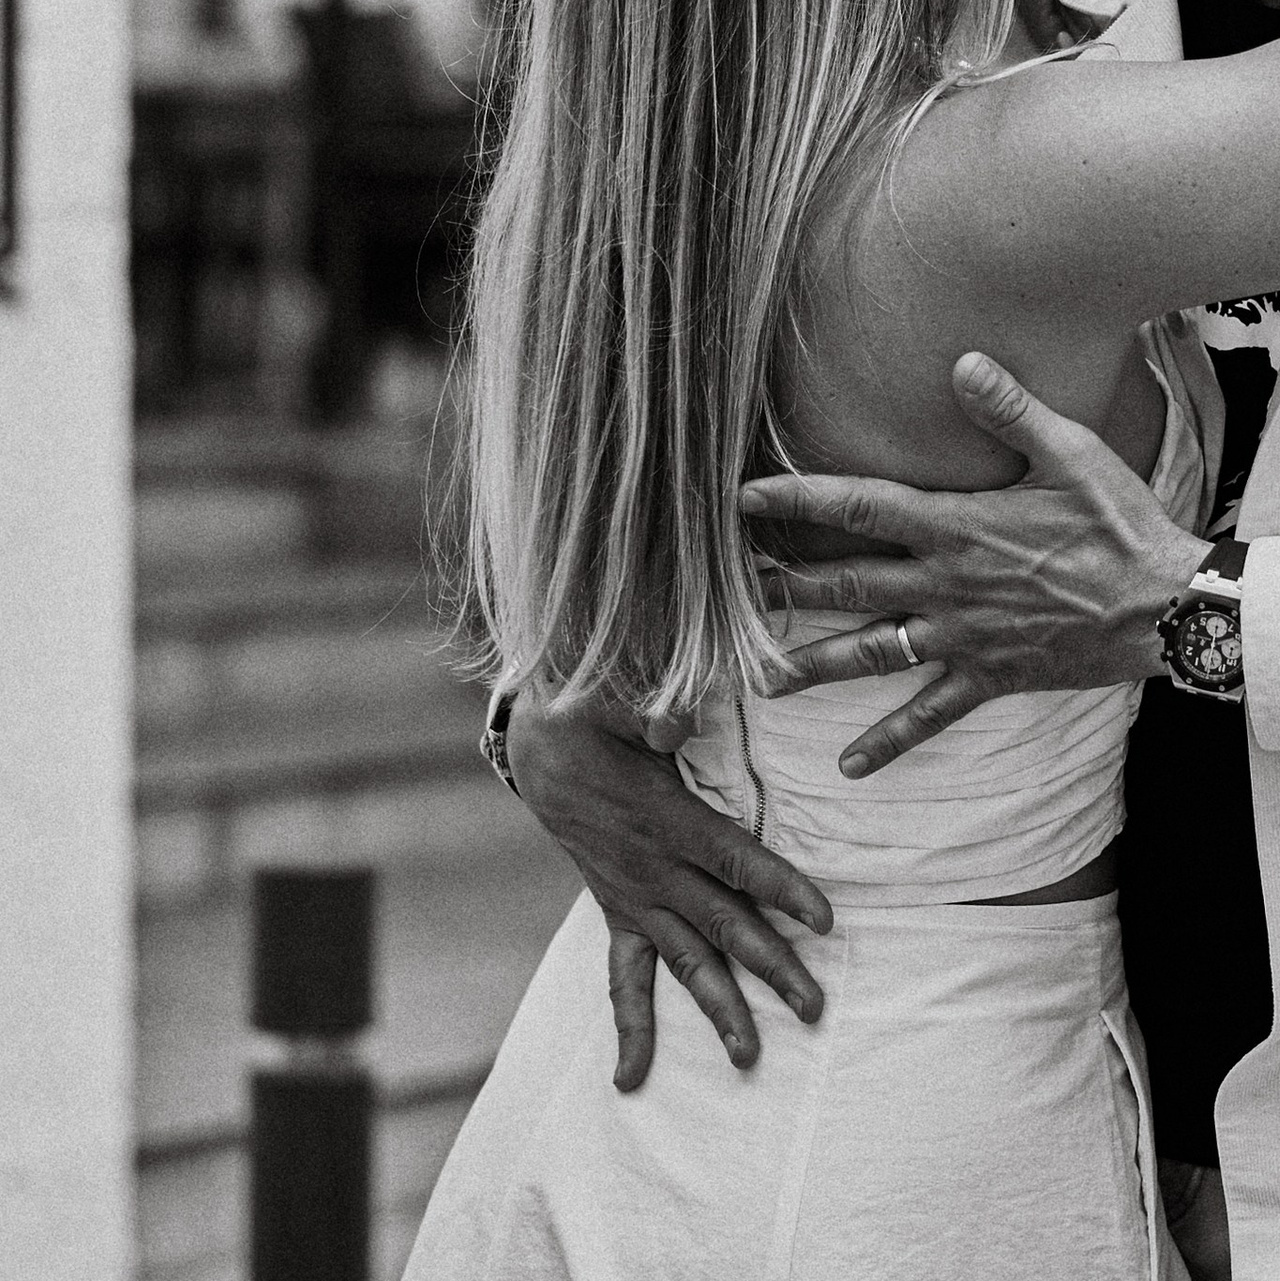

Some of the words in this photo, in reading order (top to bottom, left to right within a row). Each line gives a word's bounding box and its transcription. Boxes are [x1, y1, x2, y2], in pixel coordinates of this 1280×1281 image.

[1200, 617, 1207, 626] 5
[1190, 622, 1197, 632] 4
[1227, 623, 1234, 632] 7
[1185, 646, 1193, 656] 2
